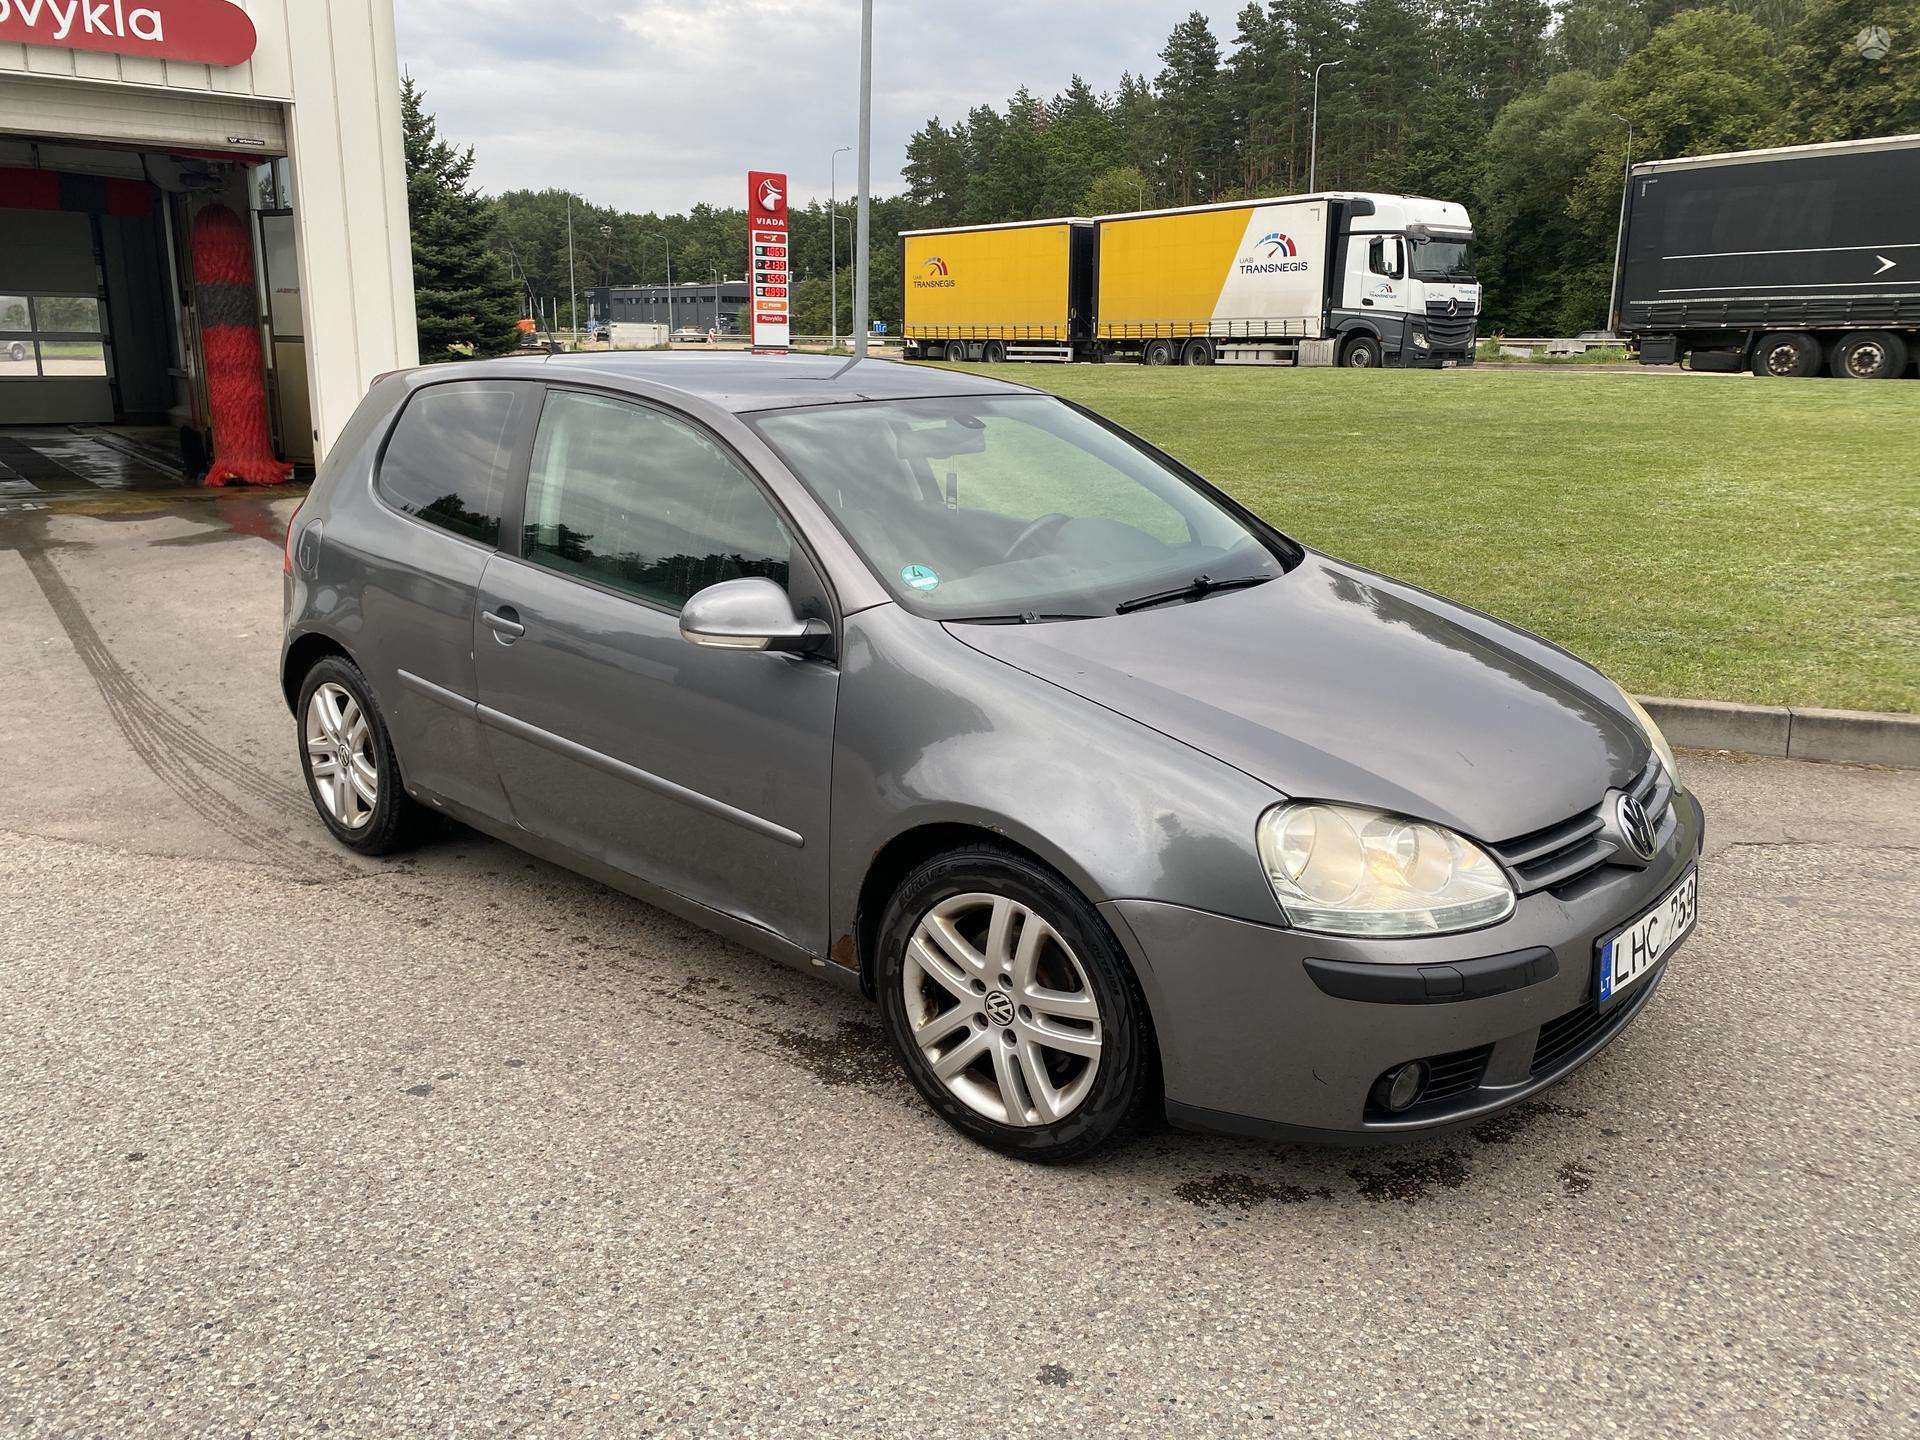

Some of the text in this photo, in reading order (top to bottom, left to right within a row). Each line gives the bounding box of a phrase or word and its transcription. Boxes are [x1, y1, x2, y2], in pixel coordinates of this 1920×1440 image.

[756, 217, 785, 226] VIADA
[1240, 261, 1308, 275] TRANSNEGIS
[914, 280, 956, 288] TRANSNEGIS
[912, 566, 924, 578] 4
[1615, 916, 1660, 986] LHC
[1600, 975, 1611, 993] LT
